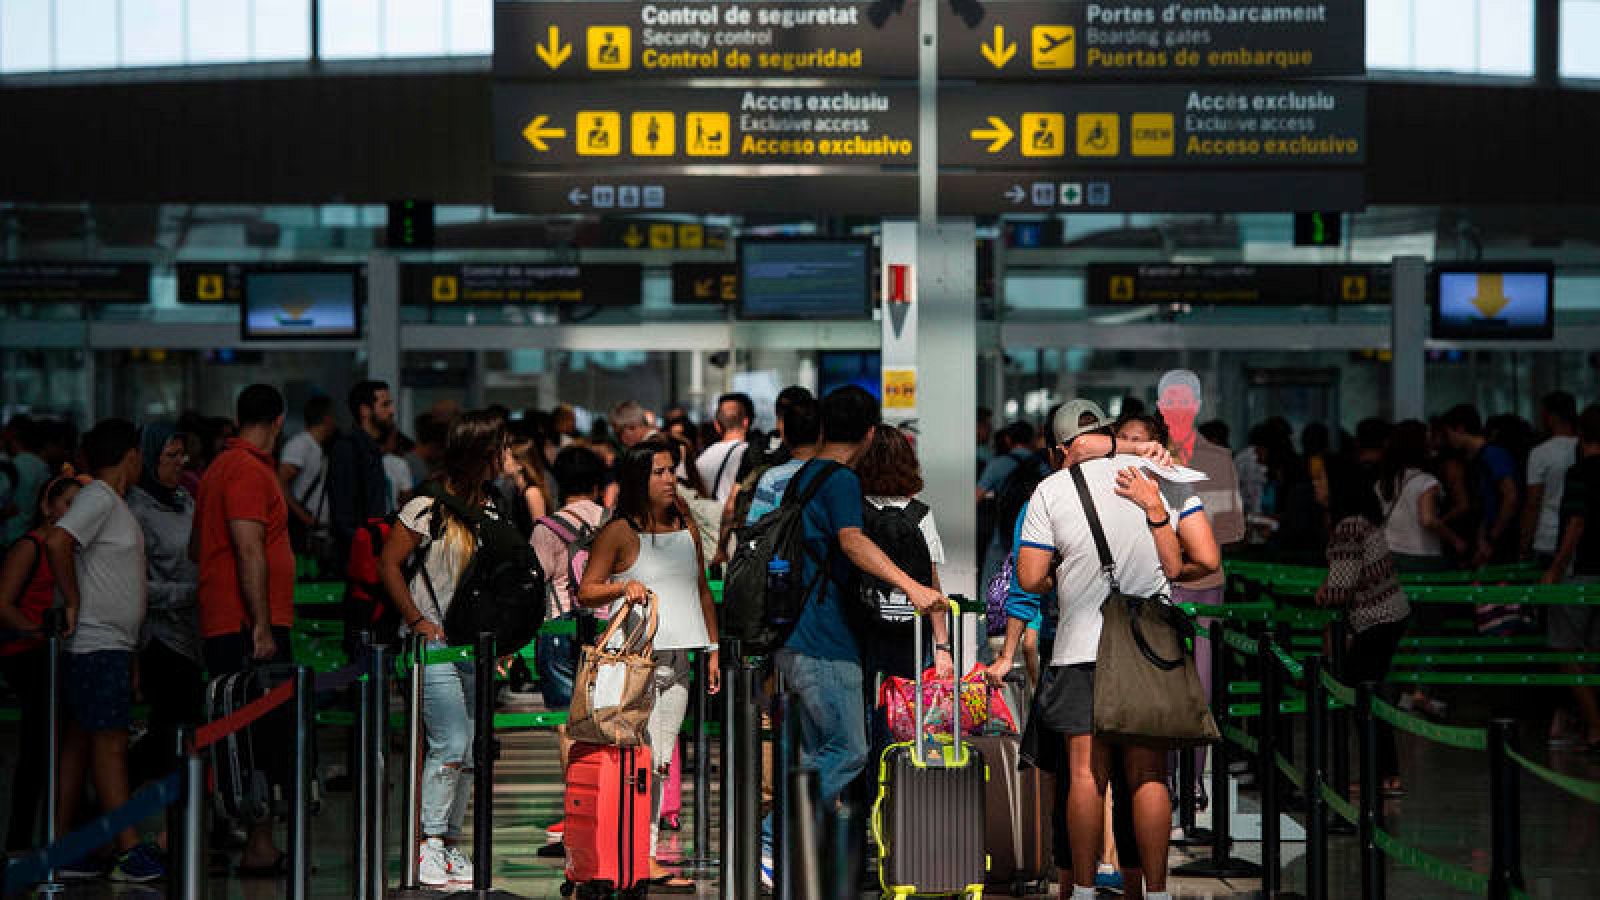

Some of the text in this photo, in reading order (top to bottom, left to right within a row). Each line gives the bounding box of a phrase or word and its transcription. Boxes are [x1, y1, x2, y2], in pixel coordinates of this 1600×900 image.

[642, 6, 859, 28] Control de seguretat
[1087, 4, 1326, 23] Portes d'embarcament
[643, 29, 772, 48] Security control
[1087, 28, 1211, 47] Boarding gates
[642, 49, 862, 71] Control de seguridad
[1087, 48, 1313, 69] Puertas de embarque
[806, 91, 889, 111] exclusiu
[1252, 91, 1335, 111] exclusiu
[740, 115, 869, 132] Exclusive access
[1186, 116, 1315, 132] Exclusive access
[741, 136, 912, 155] Acceso exclusivo
[1186, 136, 1360, 155] Acceso exclusivo
